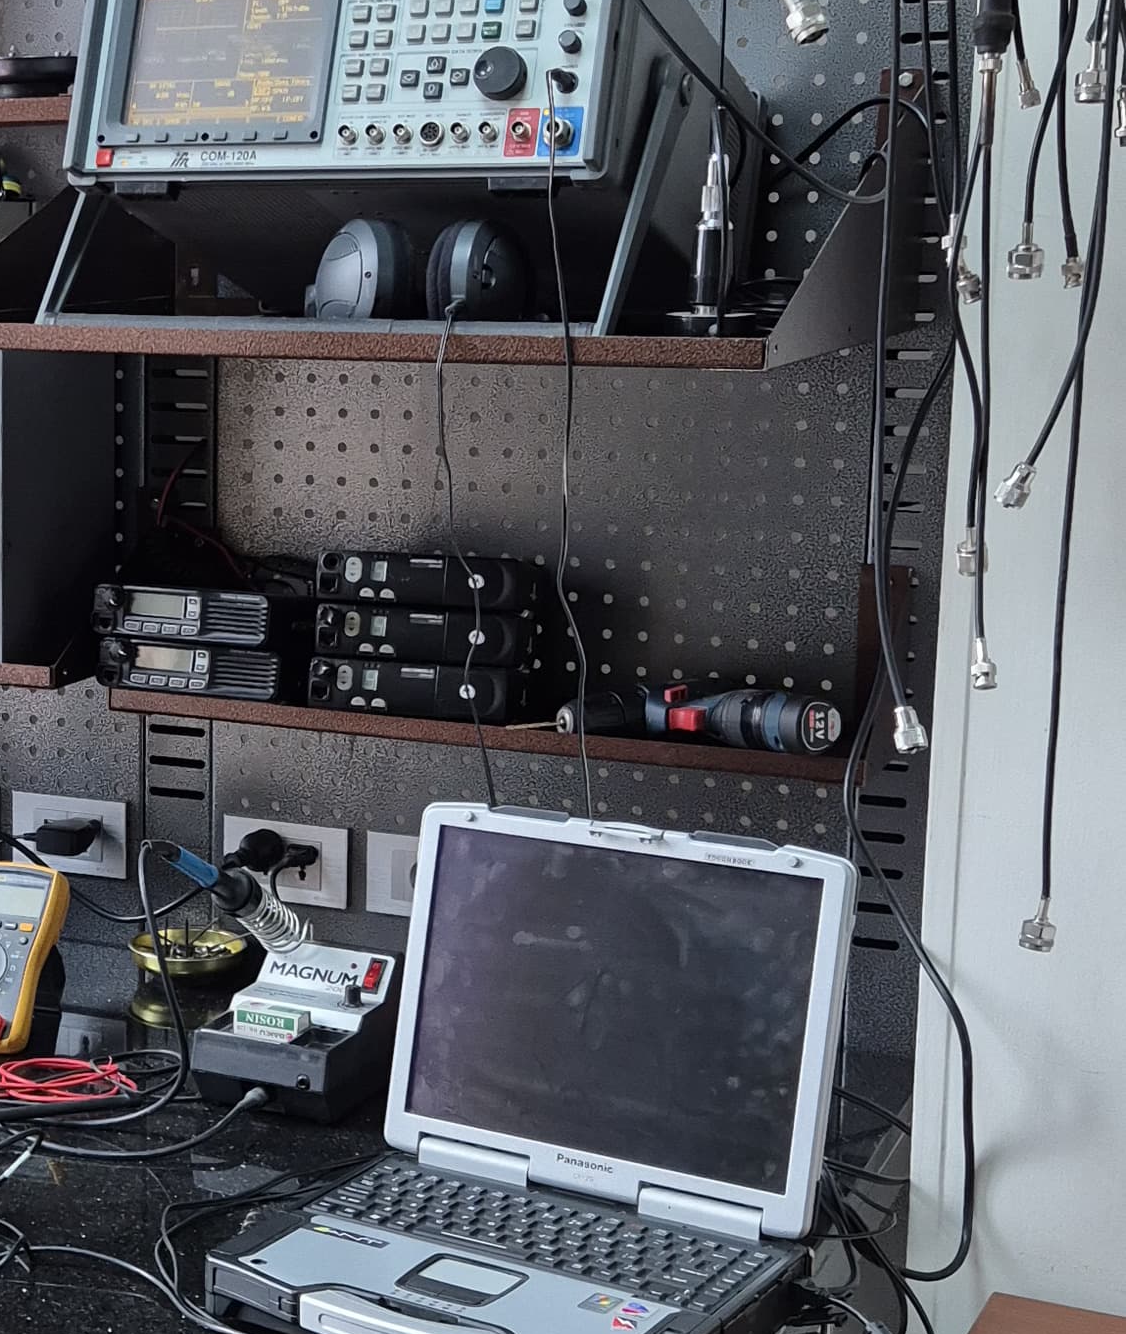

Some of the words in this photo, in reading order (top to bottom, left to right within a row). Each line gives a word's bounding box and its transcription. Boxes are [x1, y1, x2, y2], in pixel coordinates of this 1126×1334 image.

[200, 151, 257, 161] COM-120A
[815, 711, 825, 739] 12V
[270, 961, 358, 986] MAGNUM
[246, 1013, 284, 1028] ROSIN
[556, 1153, 613, 1174] Panasonic
